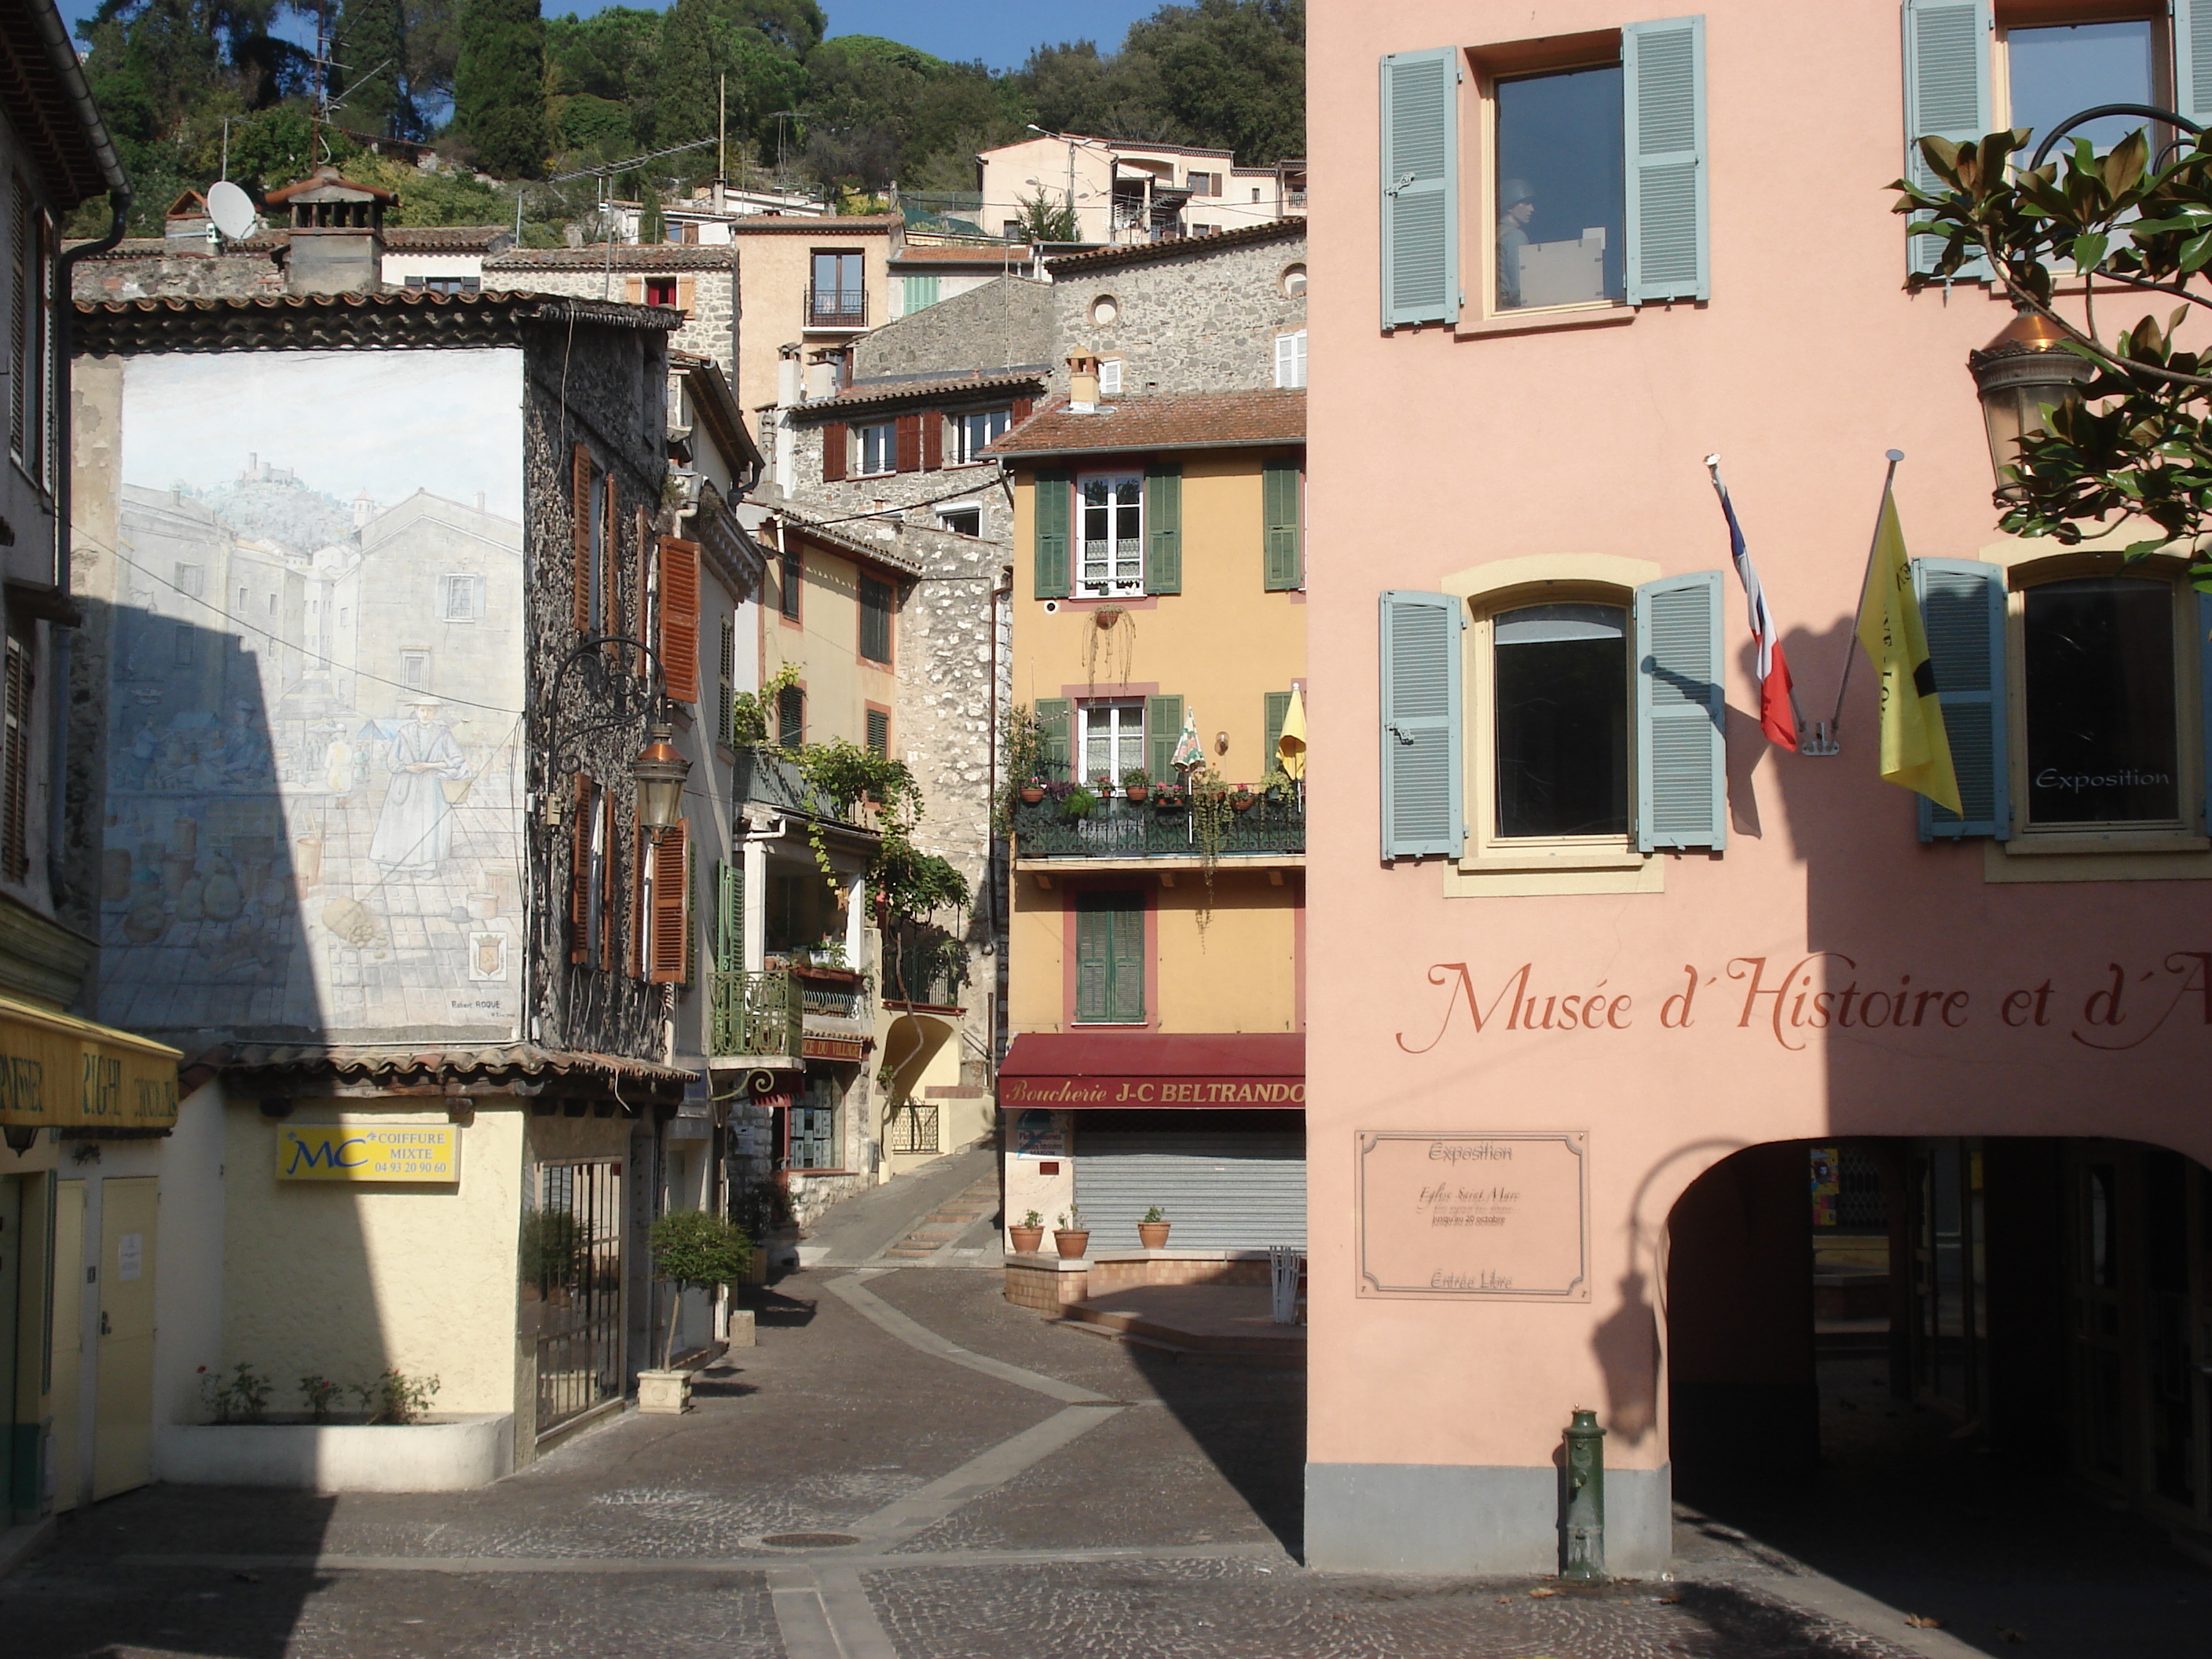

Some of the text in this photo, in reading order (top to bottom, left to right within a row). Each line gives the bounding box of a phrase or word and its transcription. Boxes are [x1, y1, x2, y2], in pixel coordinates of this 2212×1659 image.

[2035, 767, 2170, 795] Exposition
[1396, 961, 1633, 1054] Musée
[2001, 977, 2055, 1027] et
[818, 1041, 829, 1055] DU
[832, 1042, 859, 1057] VILLAGE
[1005, 1080, 1306, 1102] Boucherie J-C BELTRANDO
[378, 1133, 445, 1144] COIFFURE
[286, 1138, 369, 1175] MC
[390, 1148, 433, 1159] MIXTE
[1428, 1141, 1513, 1167] Exposition
[375, 1163, 446, 1173] 04 93 20 90 60
[1465, 1215, 1475, 1224] 20
[1476, 1215, 1506, 1225] octobre
[1430, 1268, 1513, 1289] Entrée Libre
